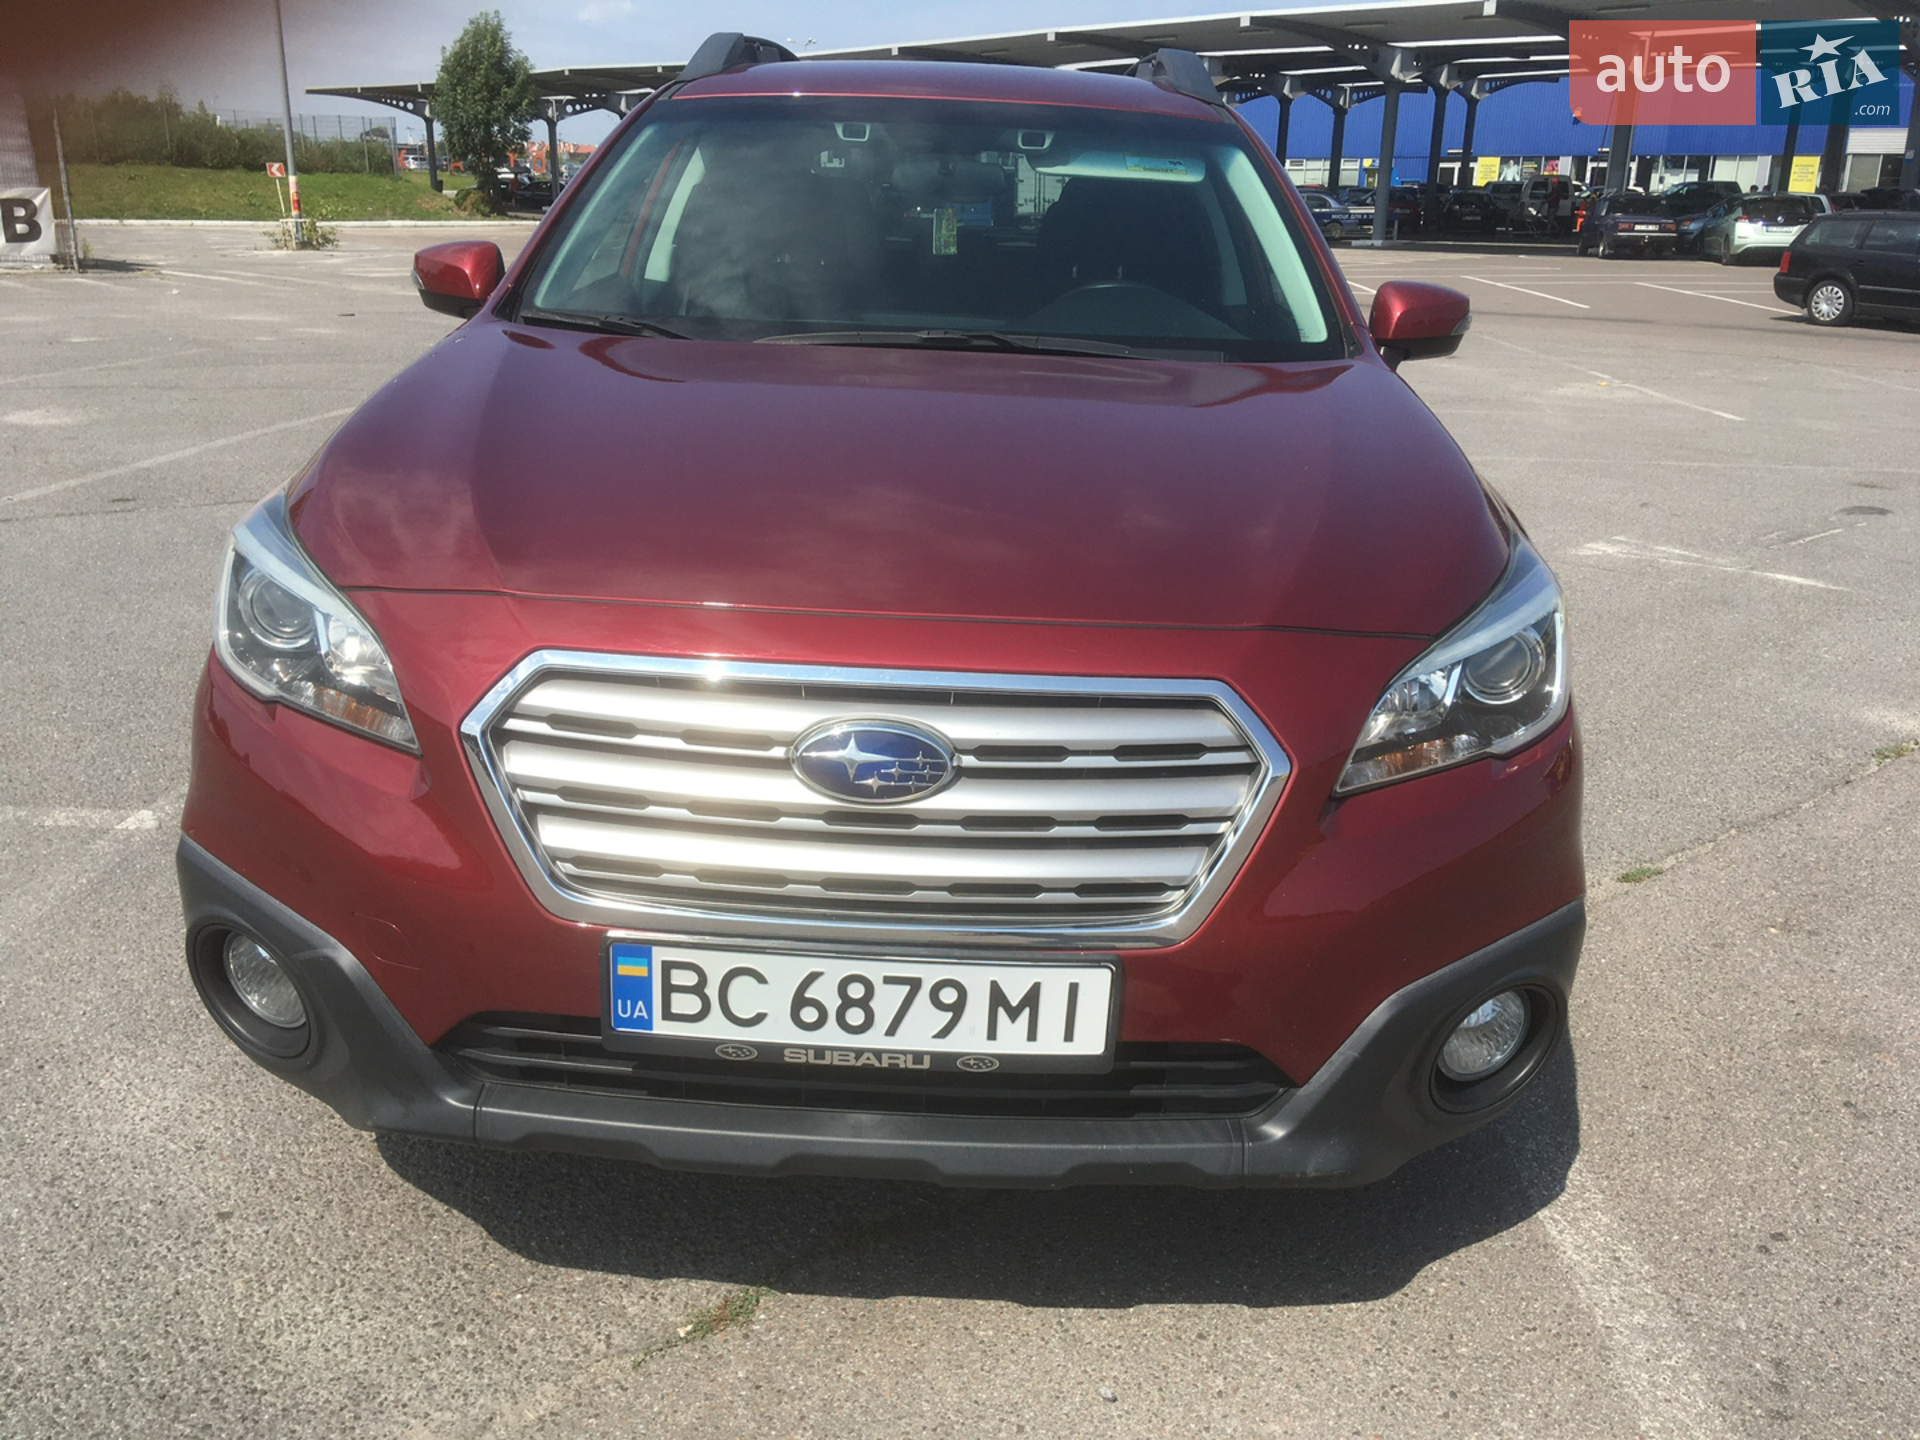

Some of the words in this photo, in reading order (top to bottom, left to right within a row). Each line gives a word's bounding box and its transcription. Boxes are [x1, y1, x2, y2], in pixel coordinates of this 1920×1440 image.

[0, 198, 42, 243] B
[617, 999, 649, 1020] UA
[661, 959, 769, 1028] BC
[790, 970, 967, 1039] 6879
[986, 979, 1079, 1043] MI
[783, 1047, 931, 1069] SUBARU
